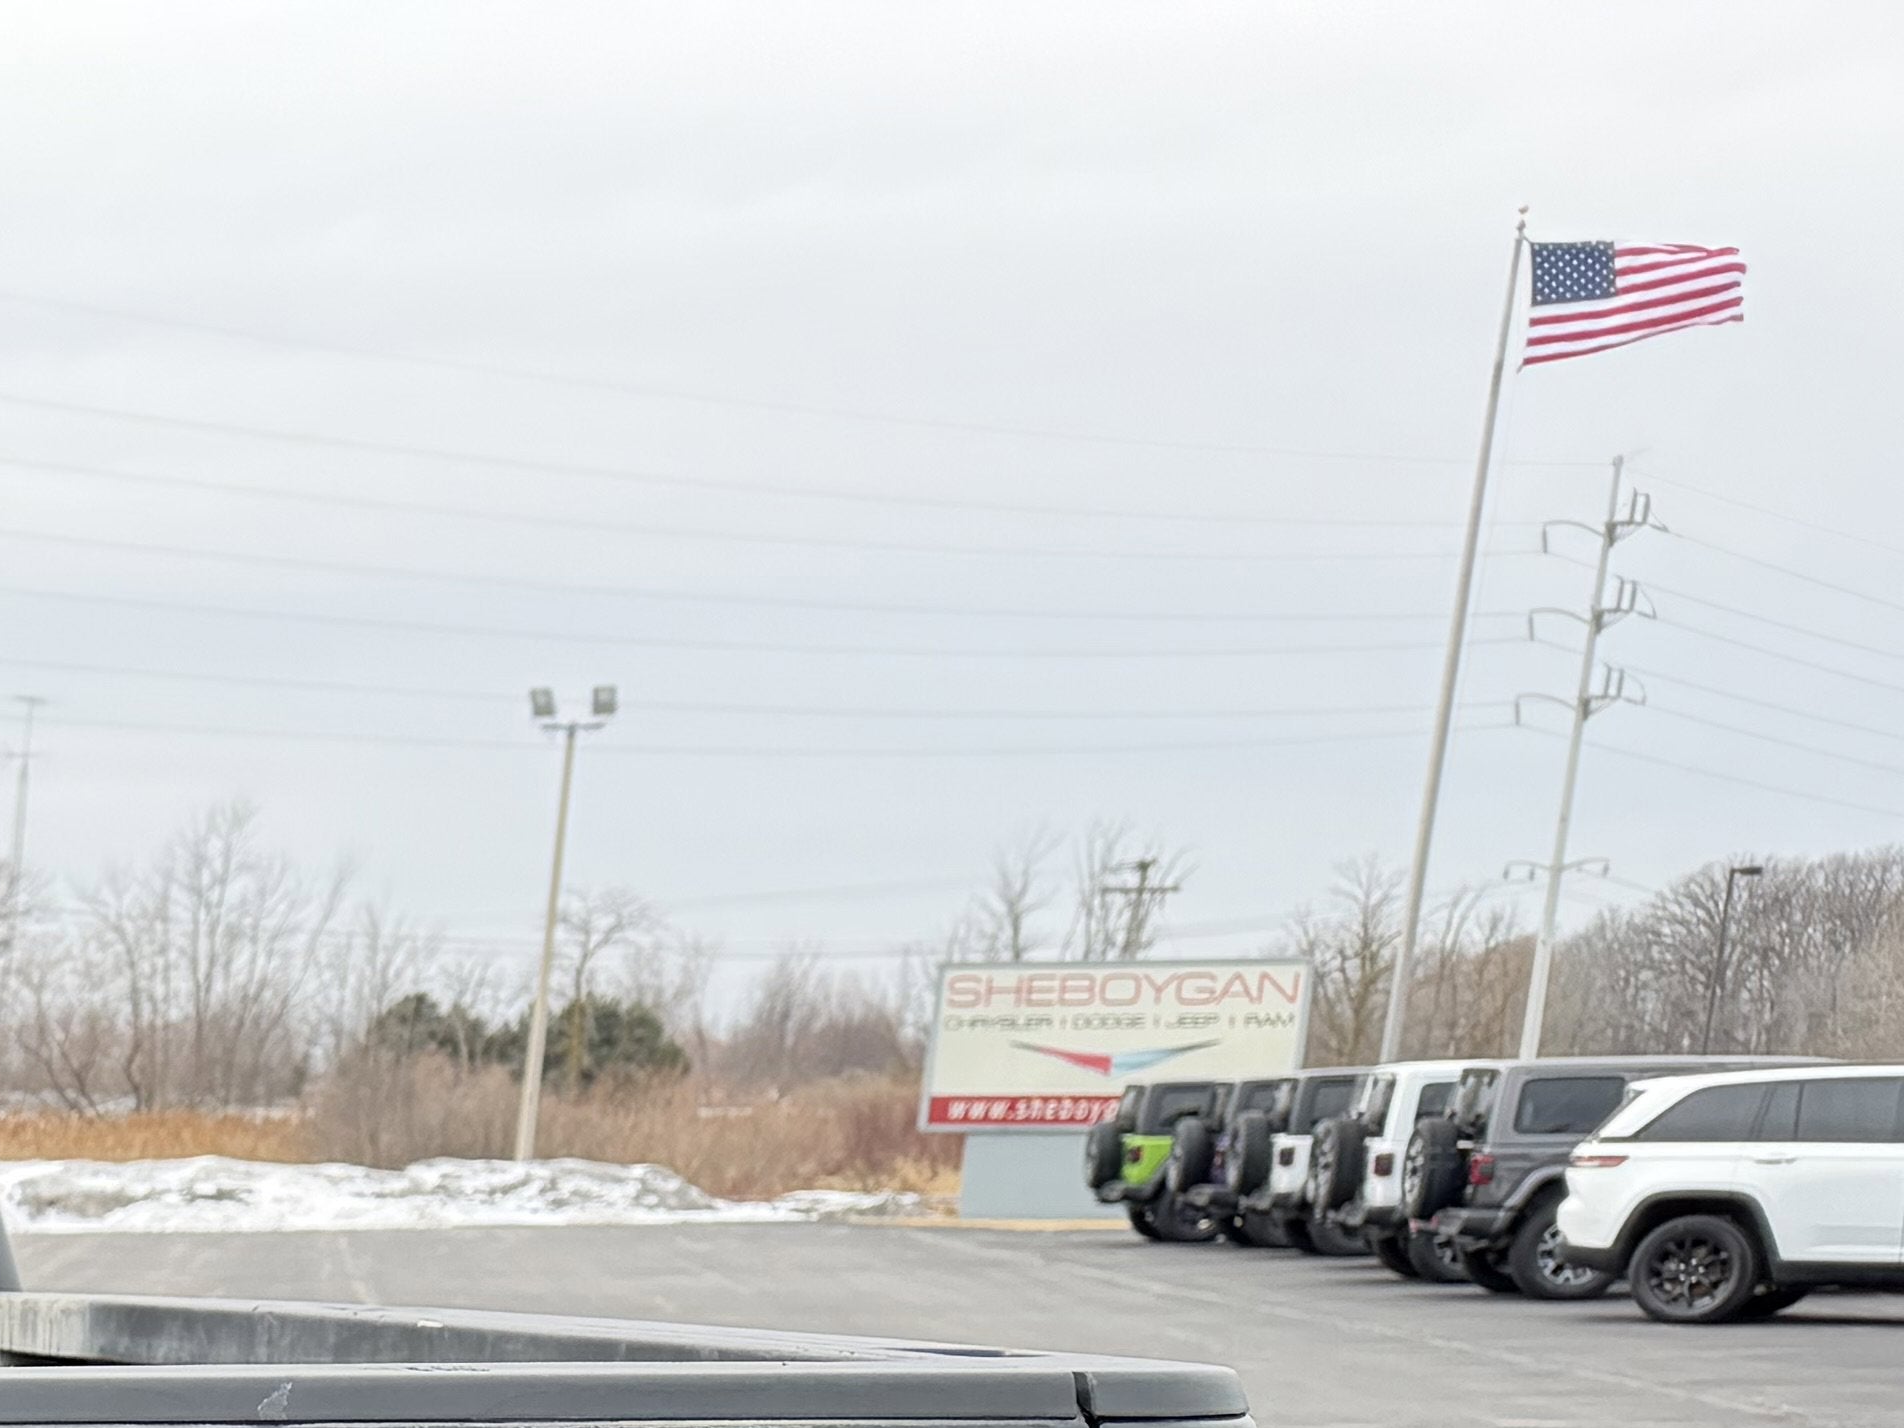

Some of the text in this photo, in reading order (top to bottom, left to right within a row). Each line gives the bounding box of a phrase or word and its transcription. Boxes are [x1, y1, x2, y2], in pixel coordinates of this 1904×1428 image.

[946, 970, 1301, 1009] SHEBOYGAN
[1072, 1013, 1147, 1030] DODGE
[1165, 1011, 1221, 1029] JEEP
[1243, 1011, 1295, 1029] RAM
